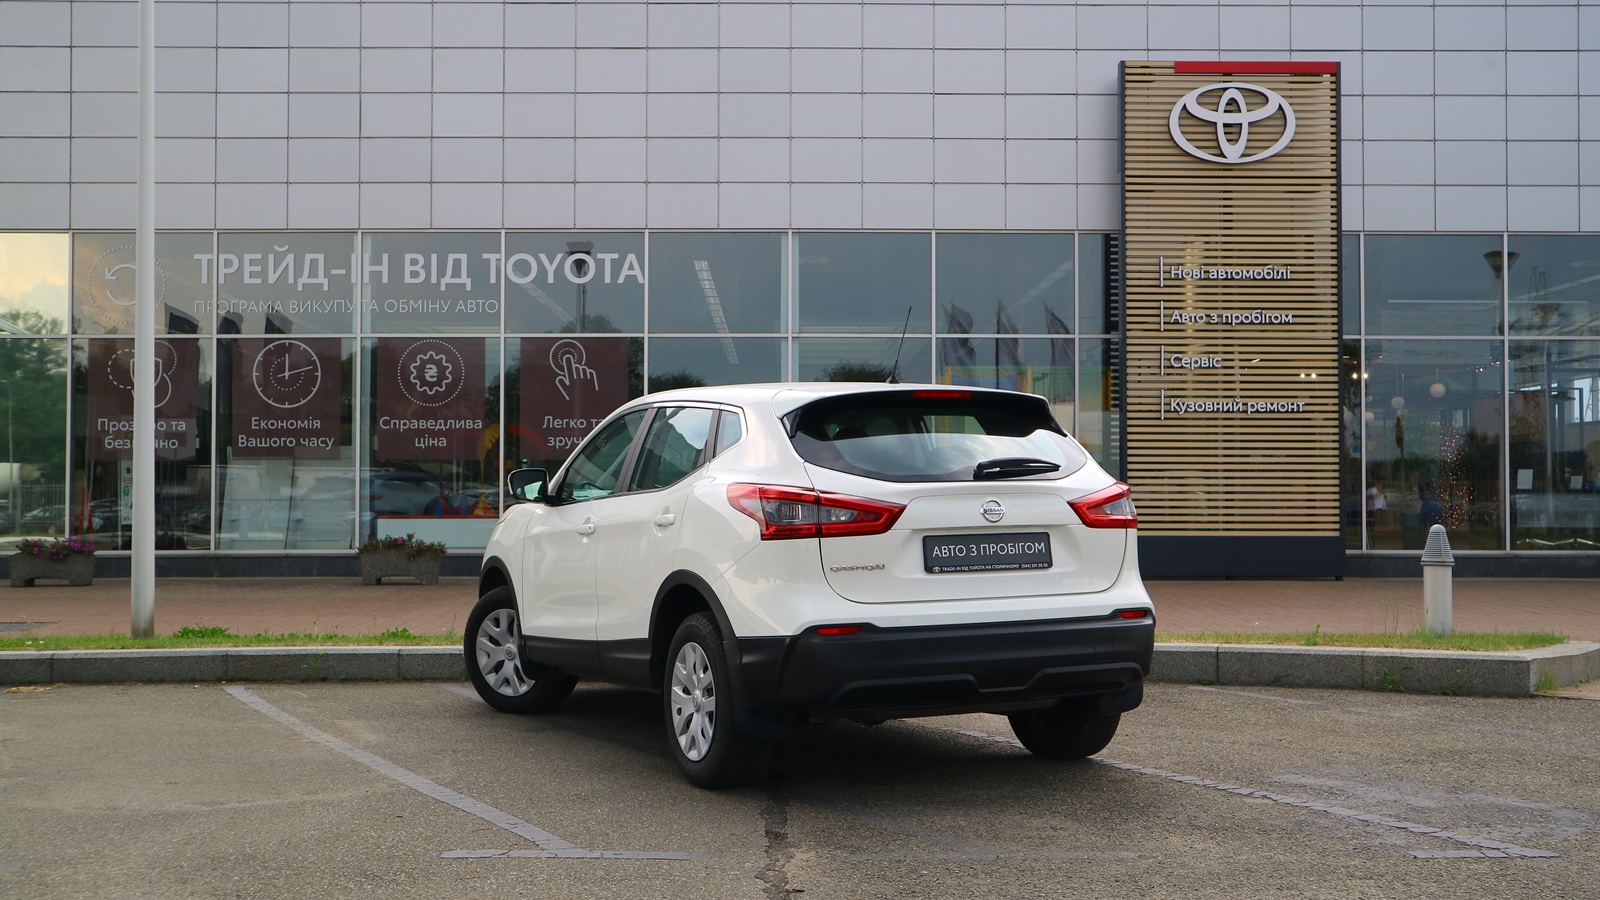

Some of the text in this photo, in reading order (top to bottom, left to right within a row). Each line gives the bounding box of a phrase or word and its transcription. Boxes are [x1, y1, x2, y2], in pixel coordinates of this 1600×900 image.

[194, 245, 645, 291] ТРЕЙД-ІН ВІД TOYOTA
[1170, 265, 1291, 280] Нові автомобілі
[194, 299, 499, 314] ПРОГРАМА ВИКУПУ ТА ОБМІНУ АВТО
[1170, 310, 1293, 326] Авто з пробігом
[1170, 354, 1222, 370] Сервіс
[1170, 398, 1305, 415] Кузовний ремонт
[170, 421, 186, 431] та
[251, 416, 321, 430] Економія
[379, 416, 483, 431] Справедлива
[542, 415, 587, 429] Легко
[238, 434, 335, 449] Вашого часу
[415, 434, 447, 449] ціна
[547, 436, 587, 449] зруч
[932, 544, 967, 558] АВТО
[981, 542, 1046, 556] ПРОБІГОМ
[830, 563, 885, 572] QASHQAI
